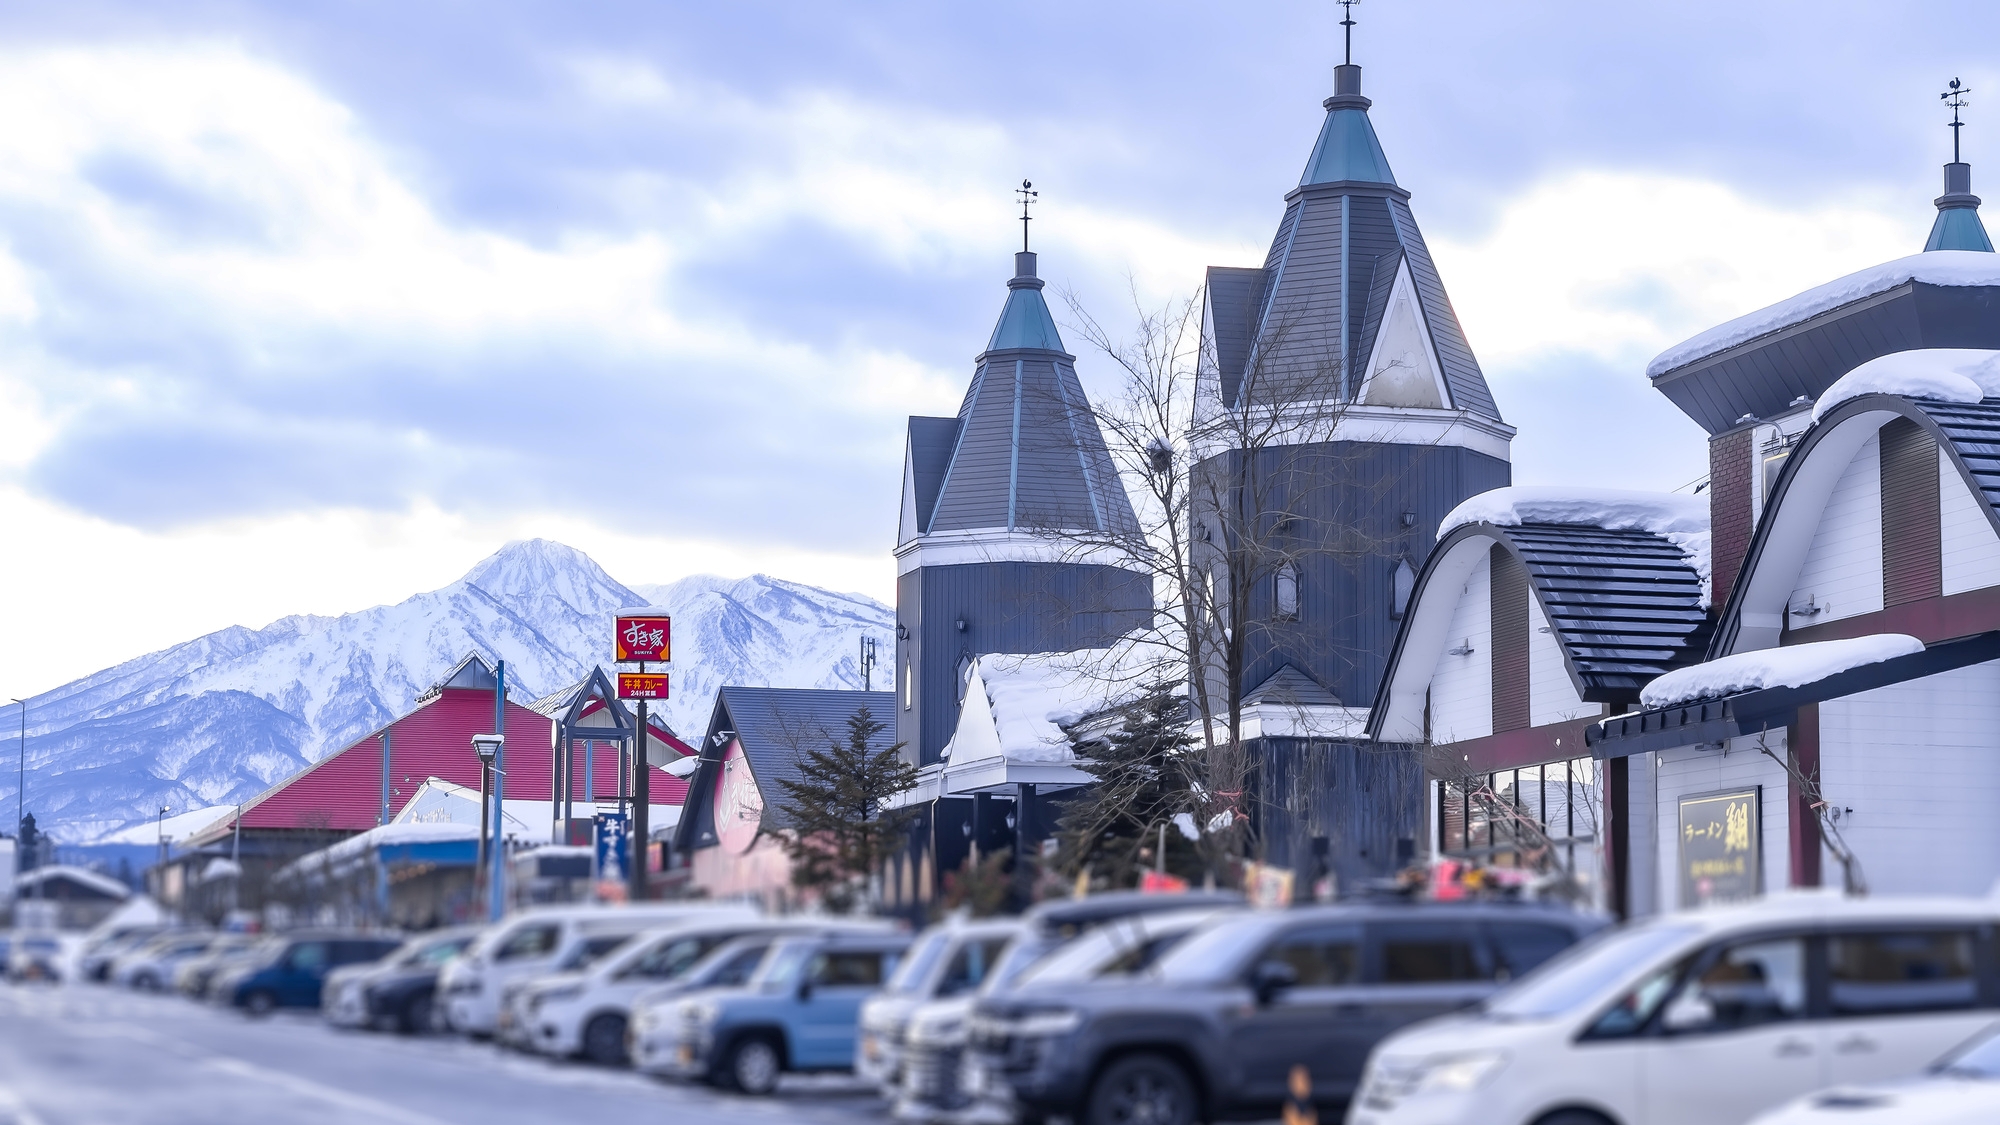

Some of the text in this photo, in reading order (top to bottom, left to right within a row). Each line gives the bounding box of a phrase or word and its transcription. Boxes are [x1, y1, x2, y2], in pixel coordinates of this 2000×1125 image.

[623, 620, 664, 651] すき家
[624, 679, 663, 689] 牛丼 カレー
[1685, 821, 1724, 843] ラーメン
[602, 818, 621, 880] 牛す
